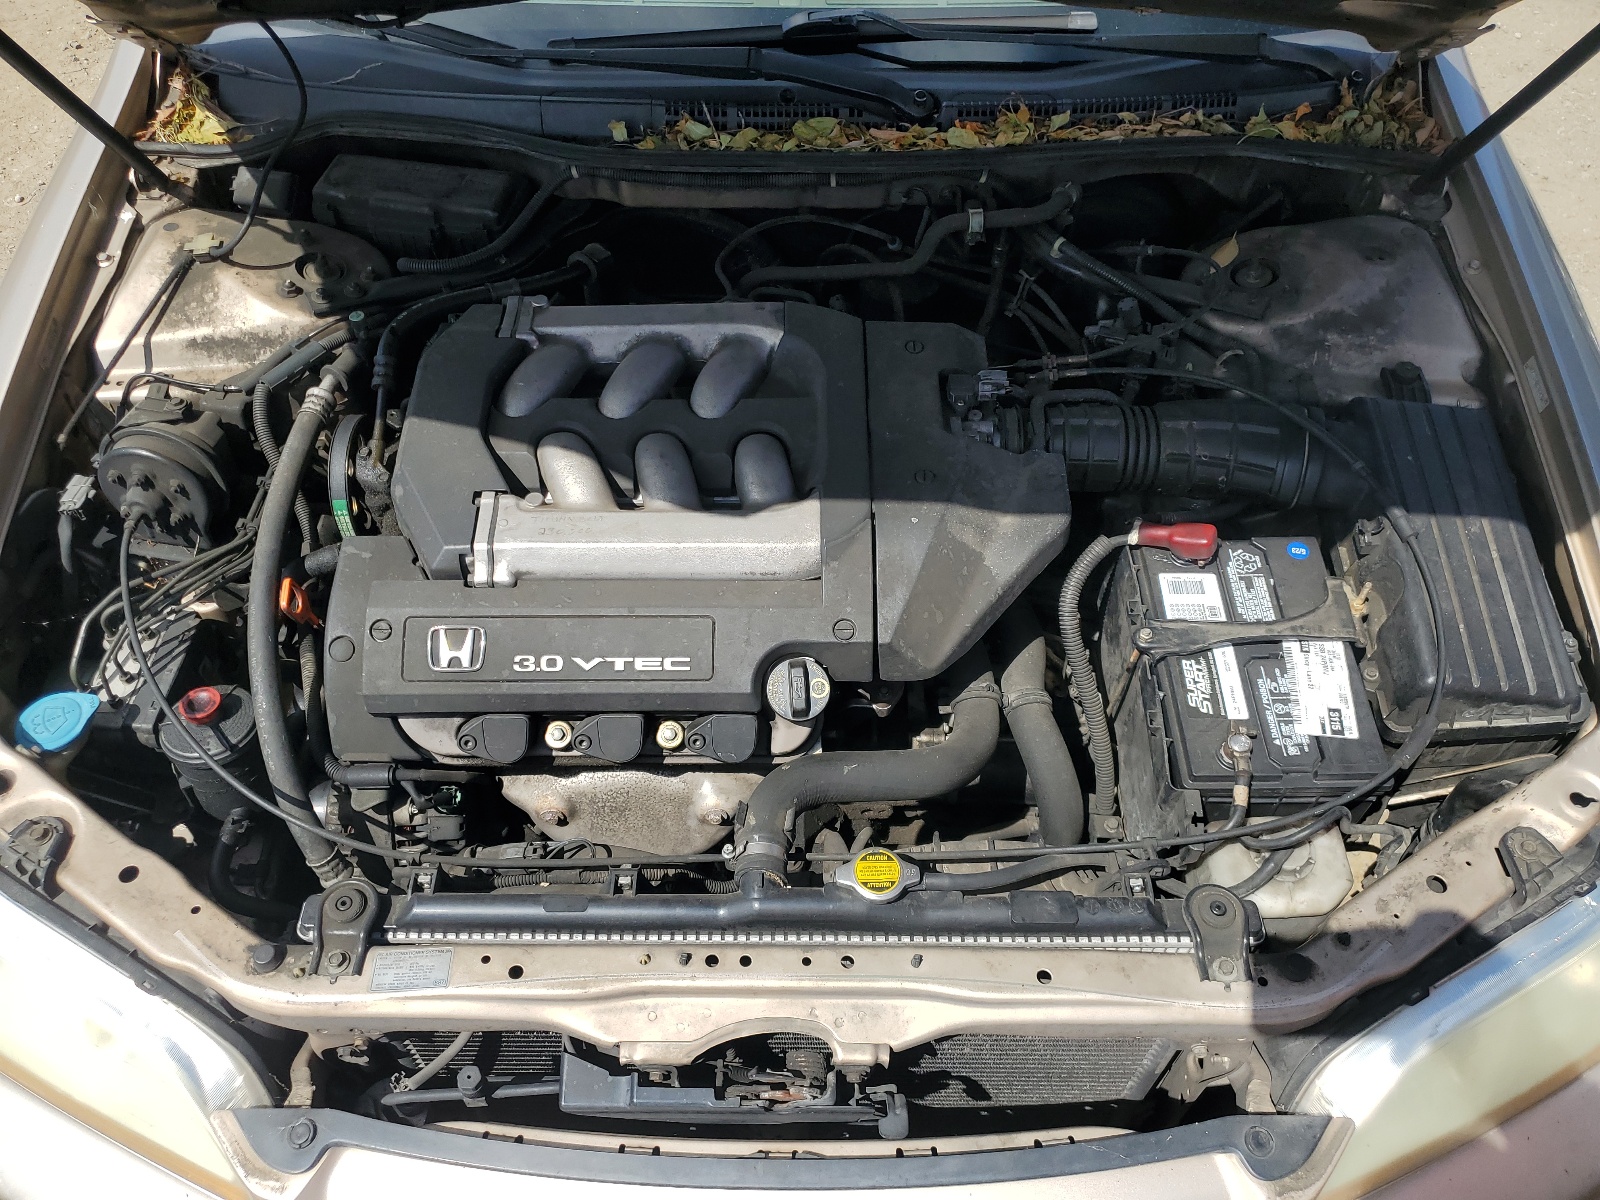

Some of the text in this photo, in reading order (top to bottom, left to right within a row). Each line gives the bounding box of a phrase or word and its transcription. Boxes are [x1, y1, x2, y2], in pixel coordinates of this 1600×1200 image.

[513, 655, 691, 672] 3.0 VTEC
[1182, 659, 1197, 708] SUPER
[1190, 659, 1214, 715] START
[1256, 678, 1269, 703] POISON
[1265, 710, 1278, 738] DANGER
[1329, 711, 1341, 731] 3115
